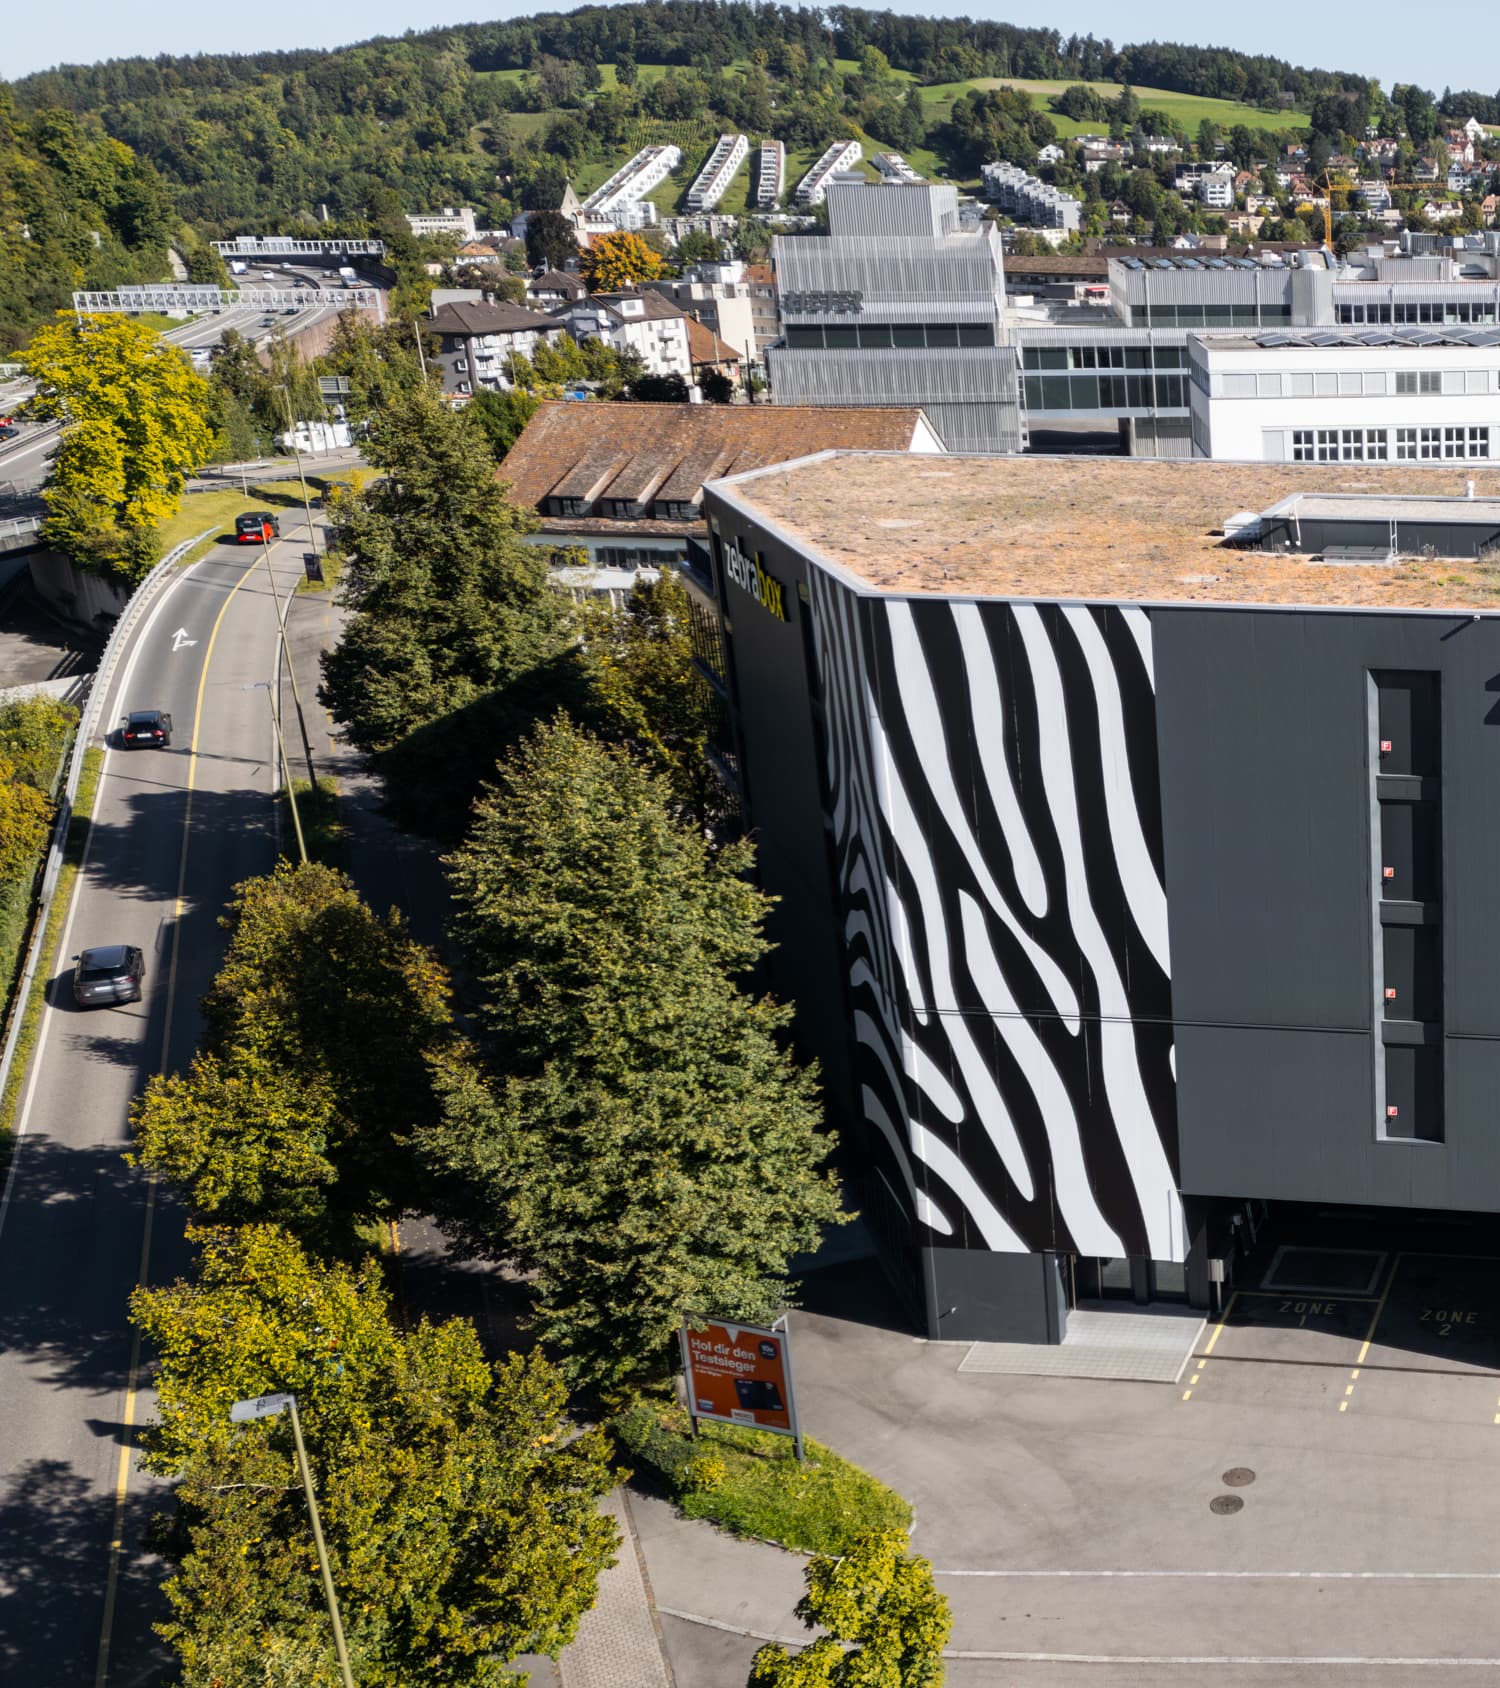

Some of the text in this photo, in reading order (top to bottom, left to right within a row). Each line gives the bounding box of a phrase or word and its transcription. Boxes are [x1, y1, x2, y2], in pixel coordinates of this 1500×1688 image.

[783, 290, 864, 314] RIETER
[724, 536, 785, 622] zebrabox
[1279, 1301, 1337, 1315] ZONE
[1420, 1310, 1480, 1324] ZONE
[1439, 1323, 1452, 1336] 2
[691, 1338, 756, 1360] Hol dir den
[692, 1350, 756, 1372] Testsieger
